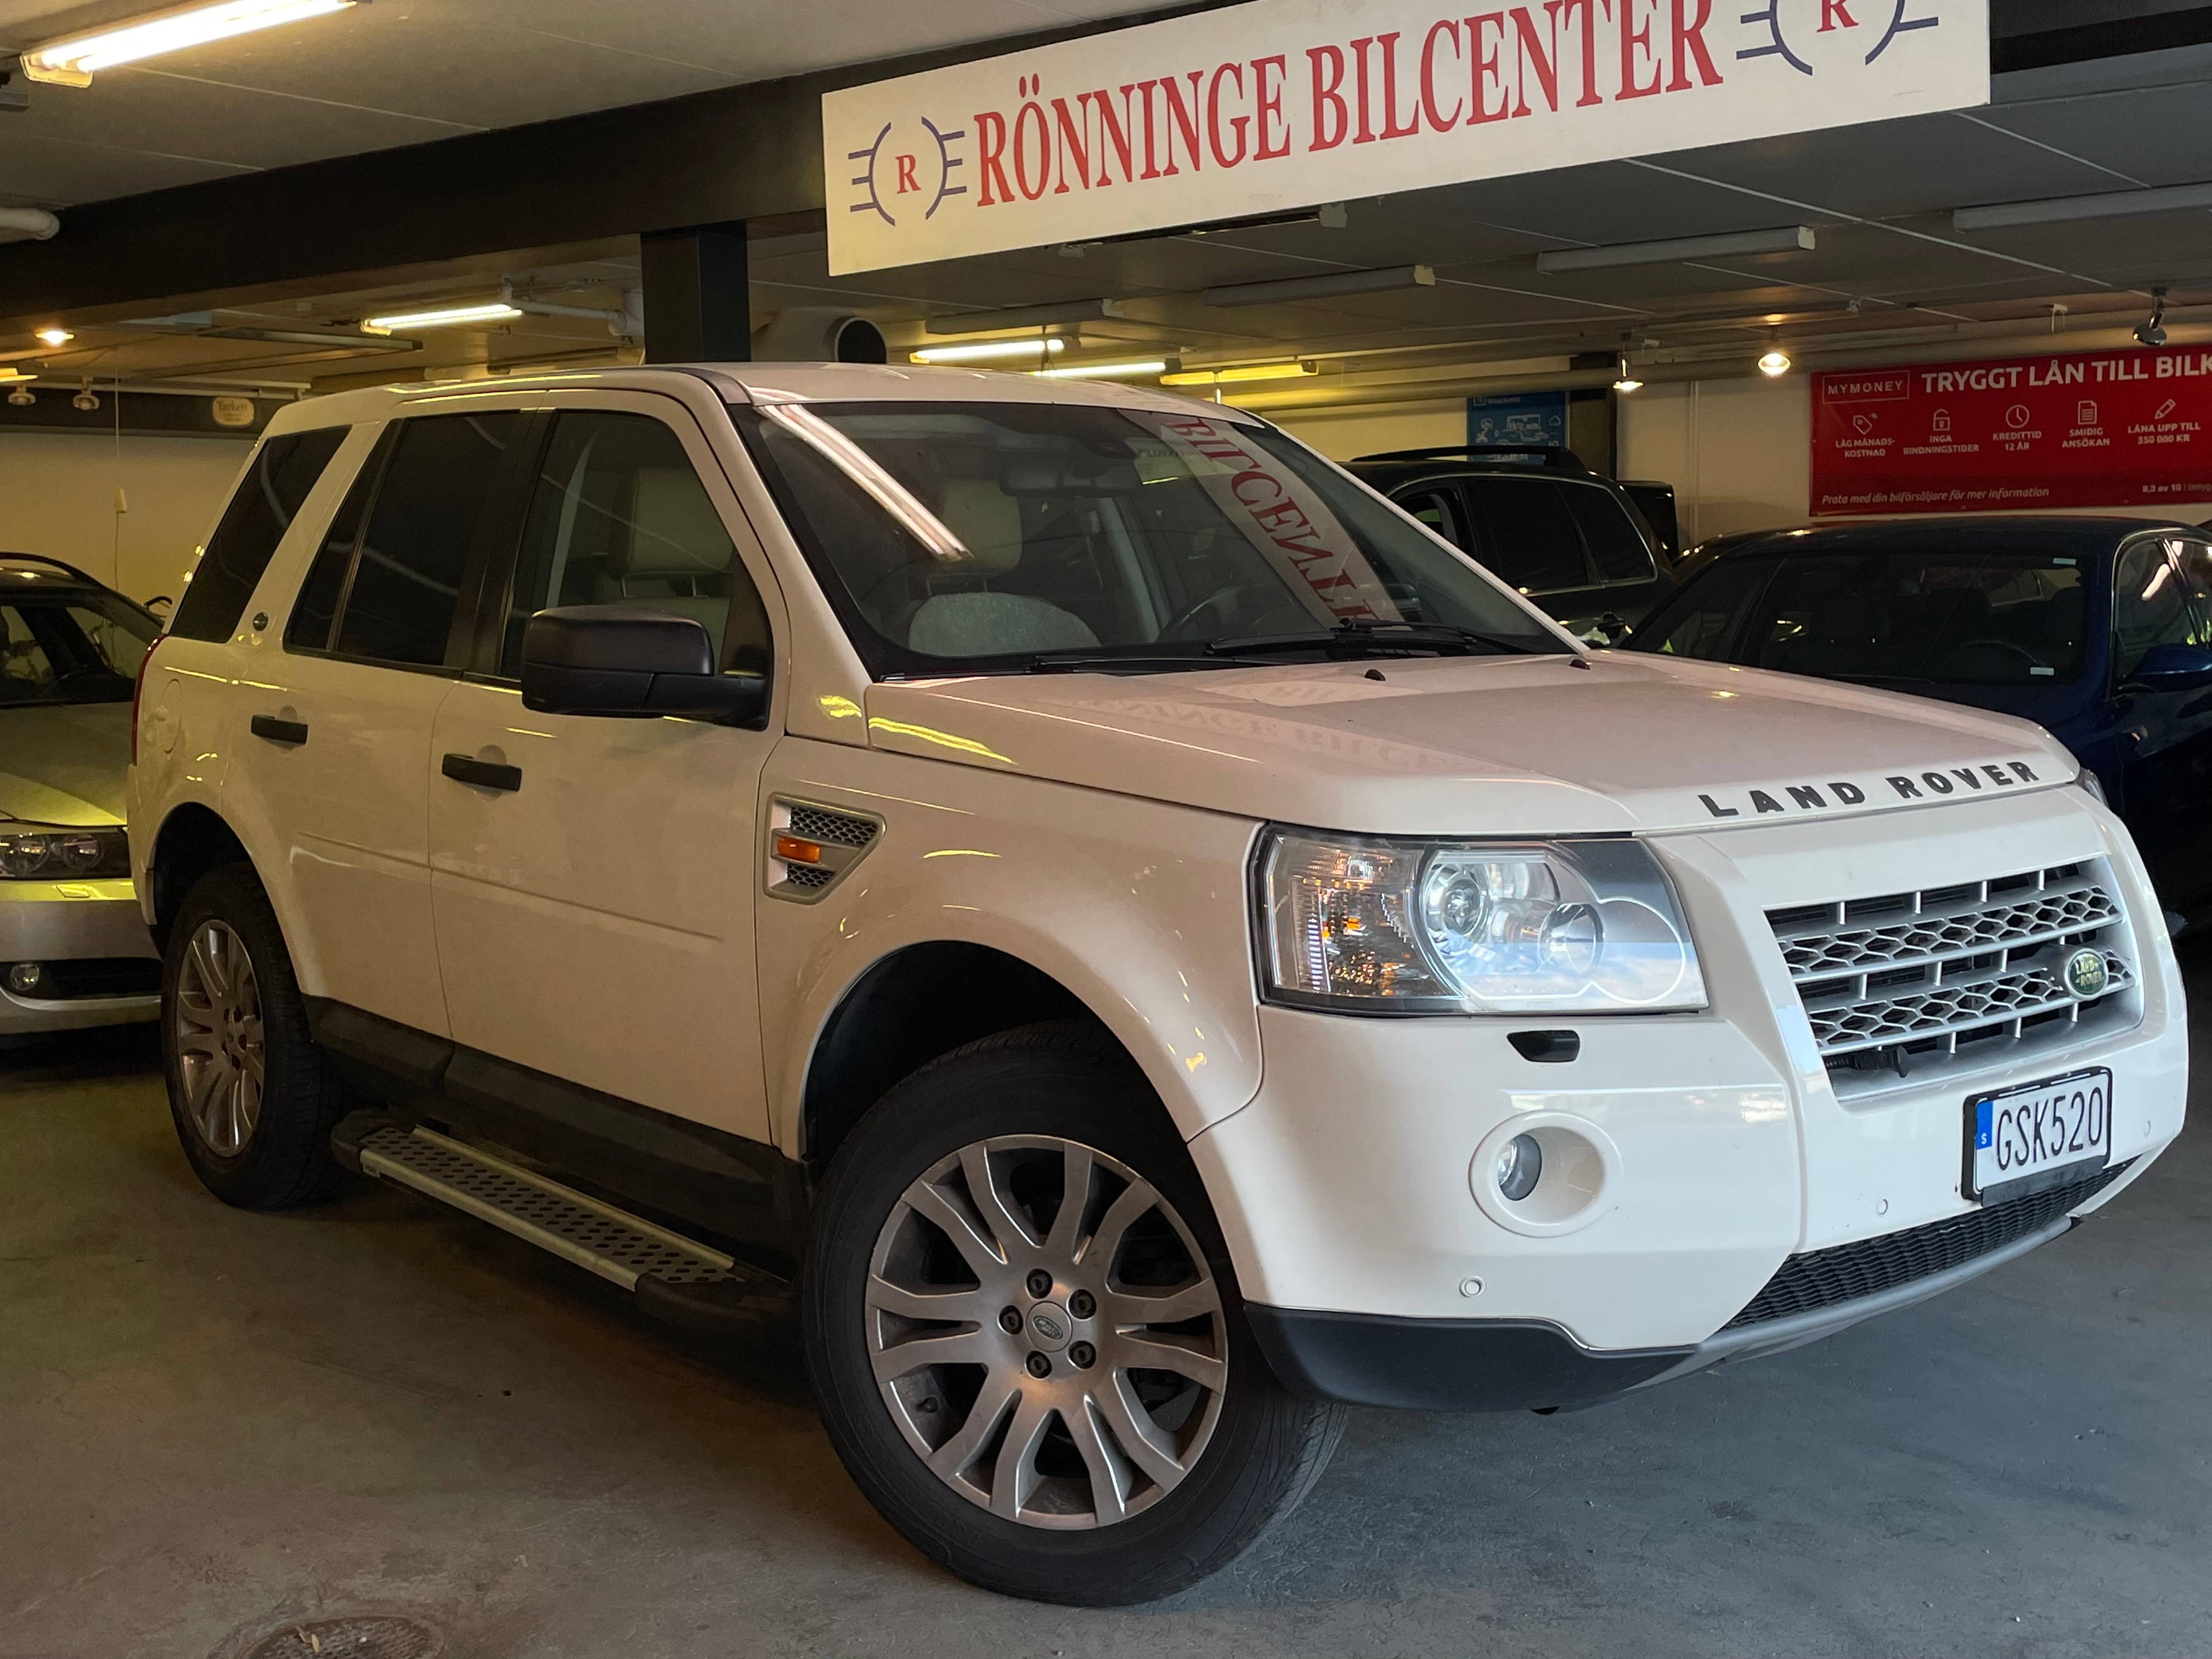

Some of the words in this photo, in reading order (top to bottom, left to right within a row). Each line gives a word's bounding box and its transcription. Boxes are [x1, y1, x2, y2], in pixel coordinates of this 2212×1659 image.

[973, 54, 1291, 207] RÖNNINGE
[1305, 0, 1723, 152] BILCENTER
[895, 154, 922, 194] R
[1921, 366, 2023, 393] TRYGGT
[2029, 359, 2084, 386] LÅN
[2091, 358, 2149, 382] TILL
[1827, 380, 1903, 396] MYMONEY
[216, 400, 247, 412] Tarkett
[2069, 427, 2103, 437] SMIDIG
[2128, 422, 2155, 434] LÅNA
[2157, 422, 2178, 432] UPP
[2180, 422, 2201, 431] TILL
[1929, 435, 1953, 443] INGA
[1992, 430, 2042, 441] KREDITTID
[2175, 433, 2191, 442] KR
[1835, 438, 1853, 449] LÅG
[1853, 437, 1895, 447] MÅNADS-
[2005, 442, 2015, 451] 12
[2016, 441, 2030, 450] ÅR
[2062, 437, 2111, 449] ANSÖKAN
[1844, 448, 1886, 458] KOSTNAD
[1903, 444, 1979, 455] BINDNINGSTIDER
[1822, 495, 1848, 505] Prata
[1849, 493, 1871, 504] med
[1872, 492, 1887, 502] din
[1889, 489, 1948, 504] bilförsäljare
[1948, 487, 1966, 501] för
[1966, 490, 1988, 500] mer
[1988, 486, 2049, 499] information
[1697, 782, 1866, 817] LAND
[1886, 760, 2040, 799] ROVER
[1996, 1087, 2103, 1171] GSK520
[1981, 1132, 1987, 1145] S
